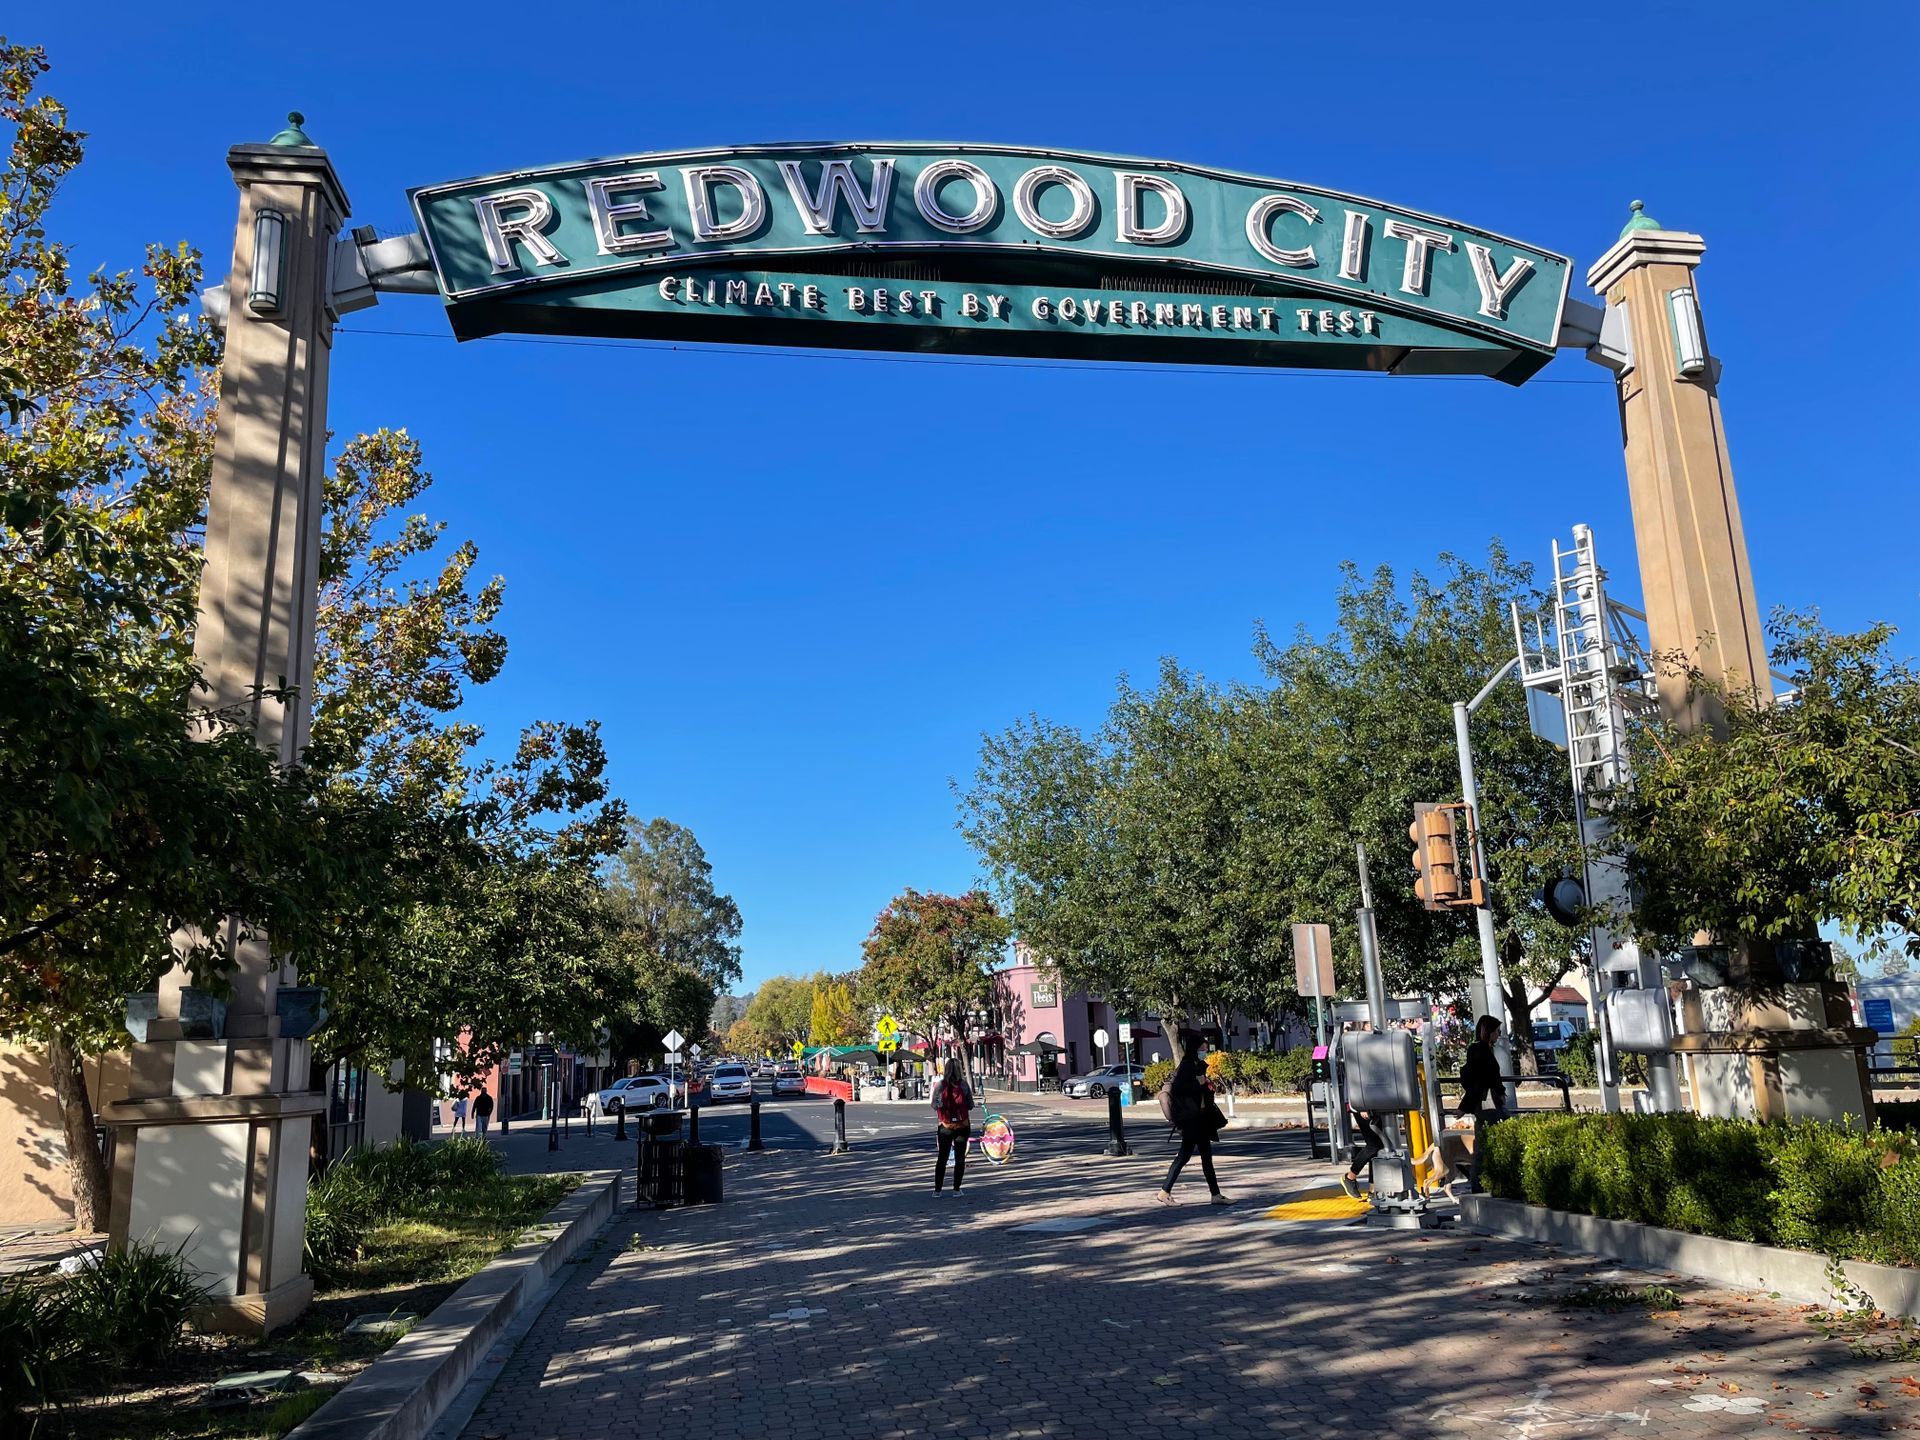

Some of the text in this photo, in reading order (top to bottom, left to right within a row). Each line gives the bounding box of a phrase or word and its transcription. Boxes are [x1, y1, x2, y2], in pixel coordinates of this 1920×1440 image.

[473, 159, 1535, 320] REDWOOD CITY
[658, 275, 1378, 335] CLIMATE BEST BY GOVERNMENT TEST
